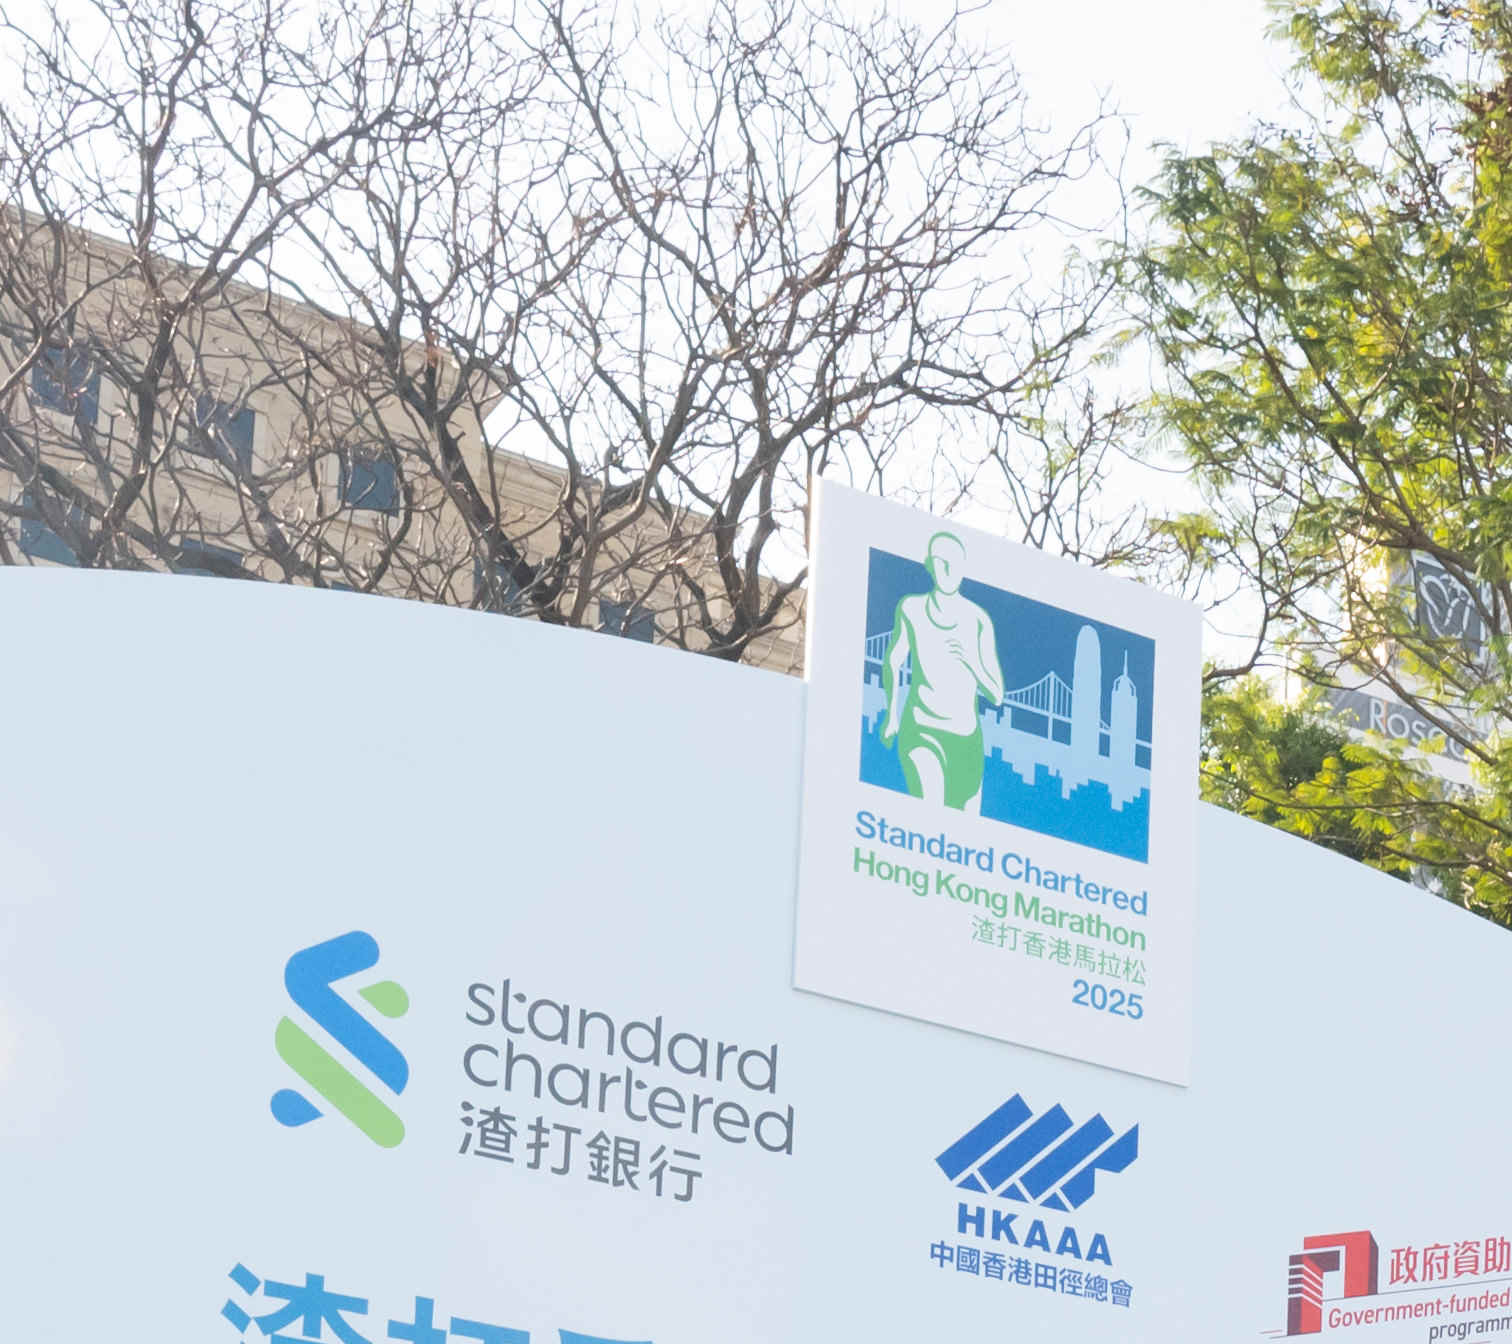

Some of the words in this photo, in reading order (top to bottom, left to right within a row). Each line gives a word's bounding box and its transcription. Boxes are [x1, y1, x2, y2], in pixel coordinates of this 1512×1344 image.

[853, 847, 930, 897] Hong
[935, 868, 1009, 920] Kong
[1013, 891, 1147, 952] Marathon
[855, 811, 994, 874] Standard
[1001, 852, 1149, 917] Chartered
[971, 914, 1147, 987] 渣打香港馬拉松
[1071, 978, 1145, 1021] 2025
[465, 978, 778, 1095] standard
[462, 1038, 795, 1156] chartered
[458, 1100, 704, 1203] 渣打銀行
[957, 1201, 1113, 1267] HKAAA
[1389, 1235, 1512, 1286] 政府資助
[929, 1239, 1134, 1309] 中國香港田徑總會
[1328, 1287, 1511, 1329] Government-funded
